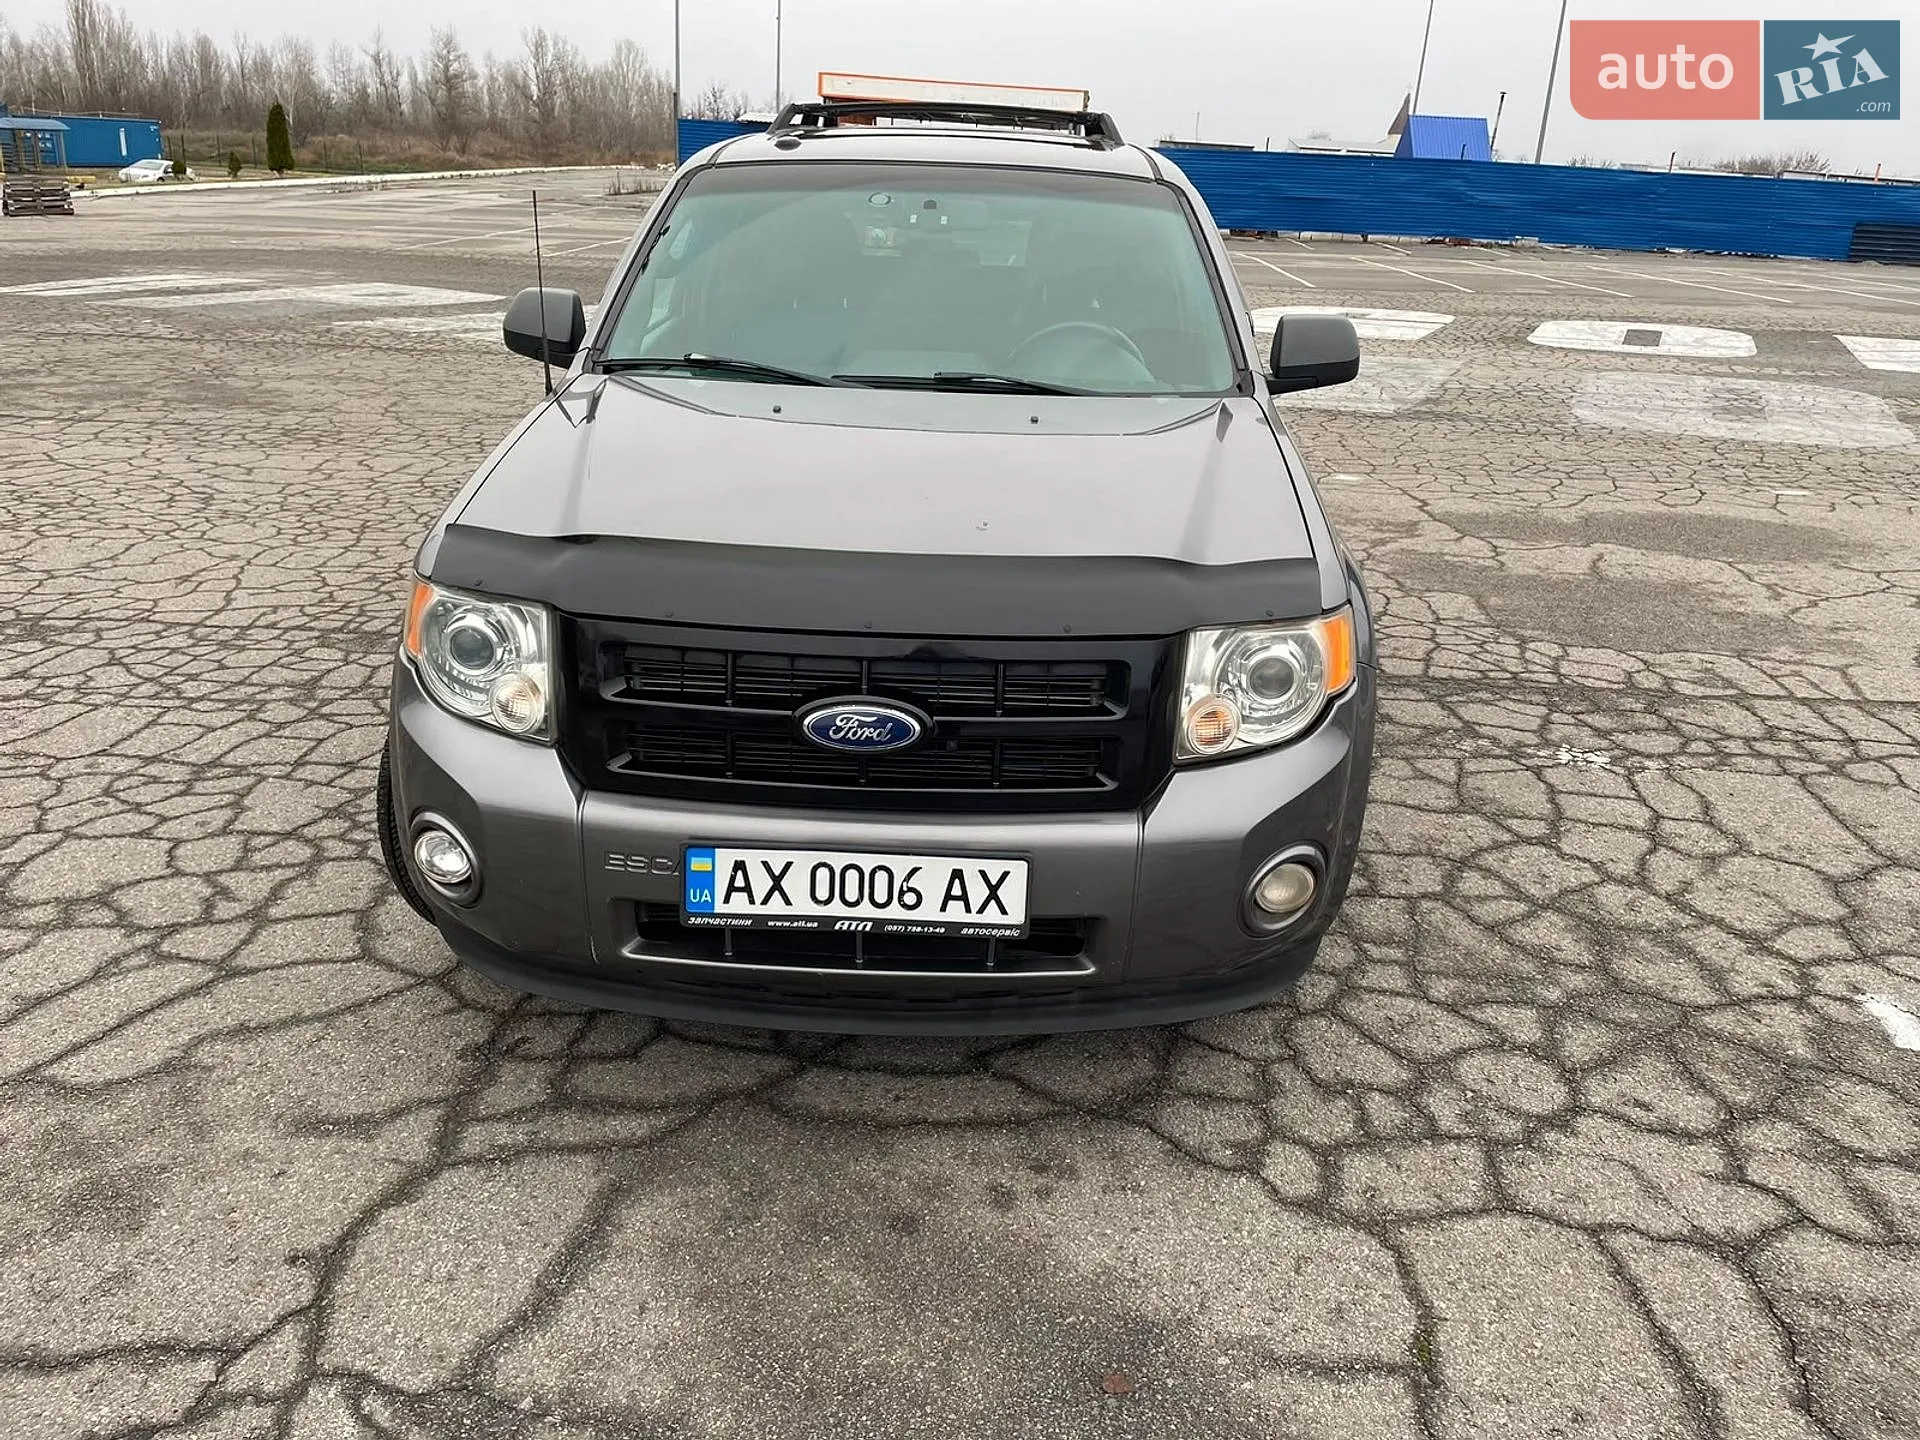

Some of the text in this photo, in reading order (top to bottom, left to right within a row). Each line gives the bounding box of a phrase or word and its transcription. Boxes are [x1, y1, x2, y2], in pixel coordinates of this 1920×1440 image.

[829, 714, 892, 741] Ford
[690, 888, 712, 903] UA
[723, 859, 1010, 915] AX 0006 AX
